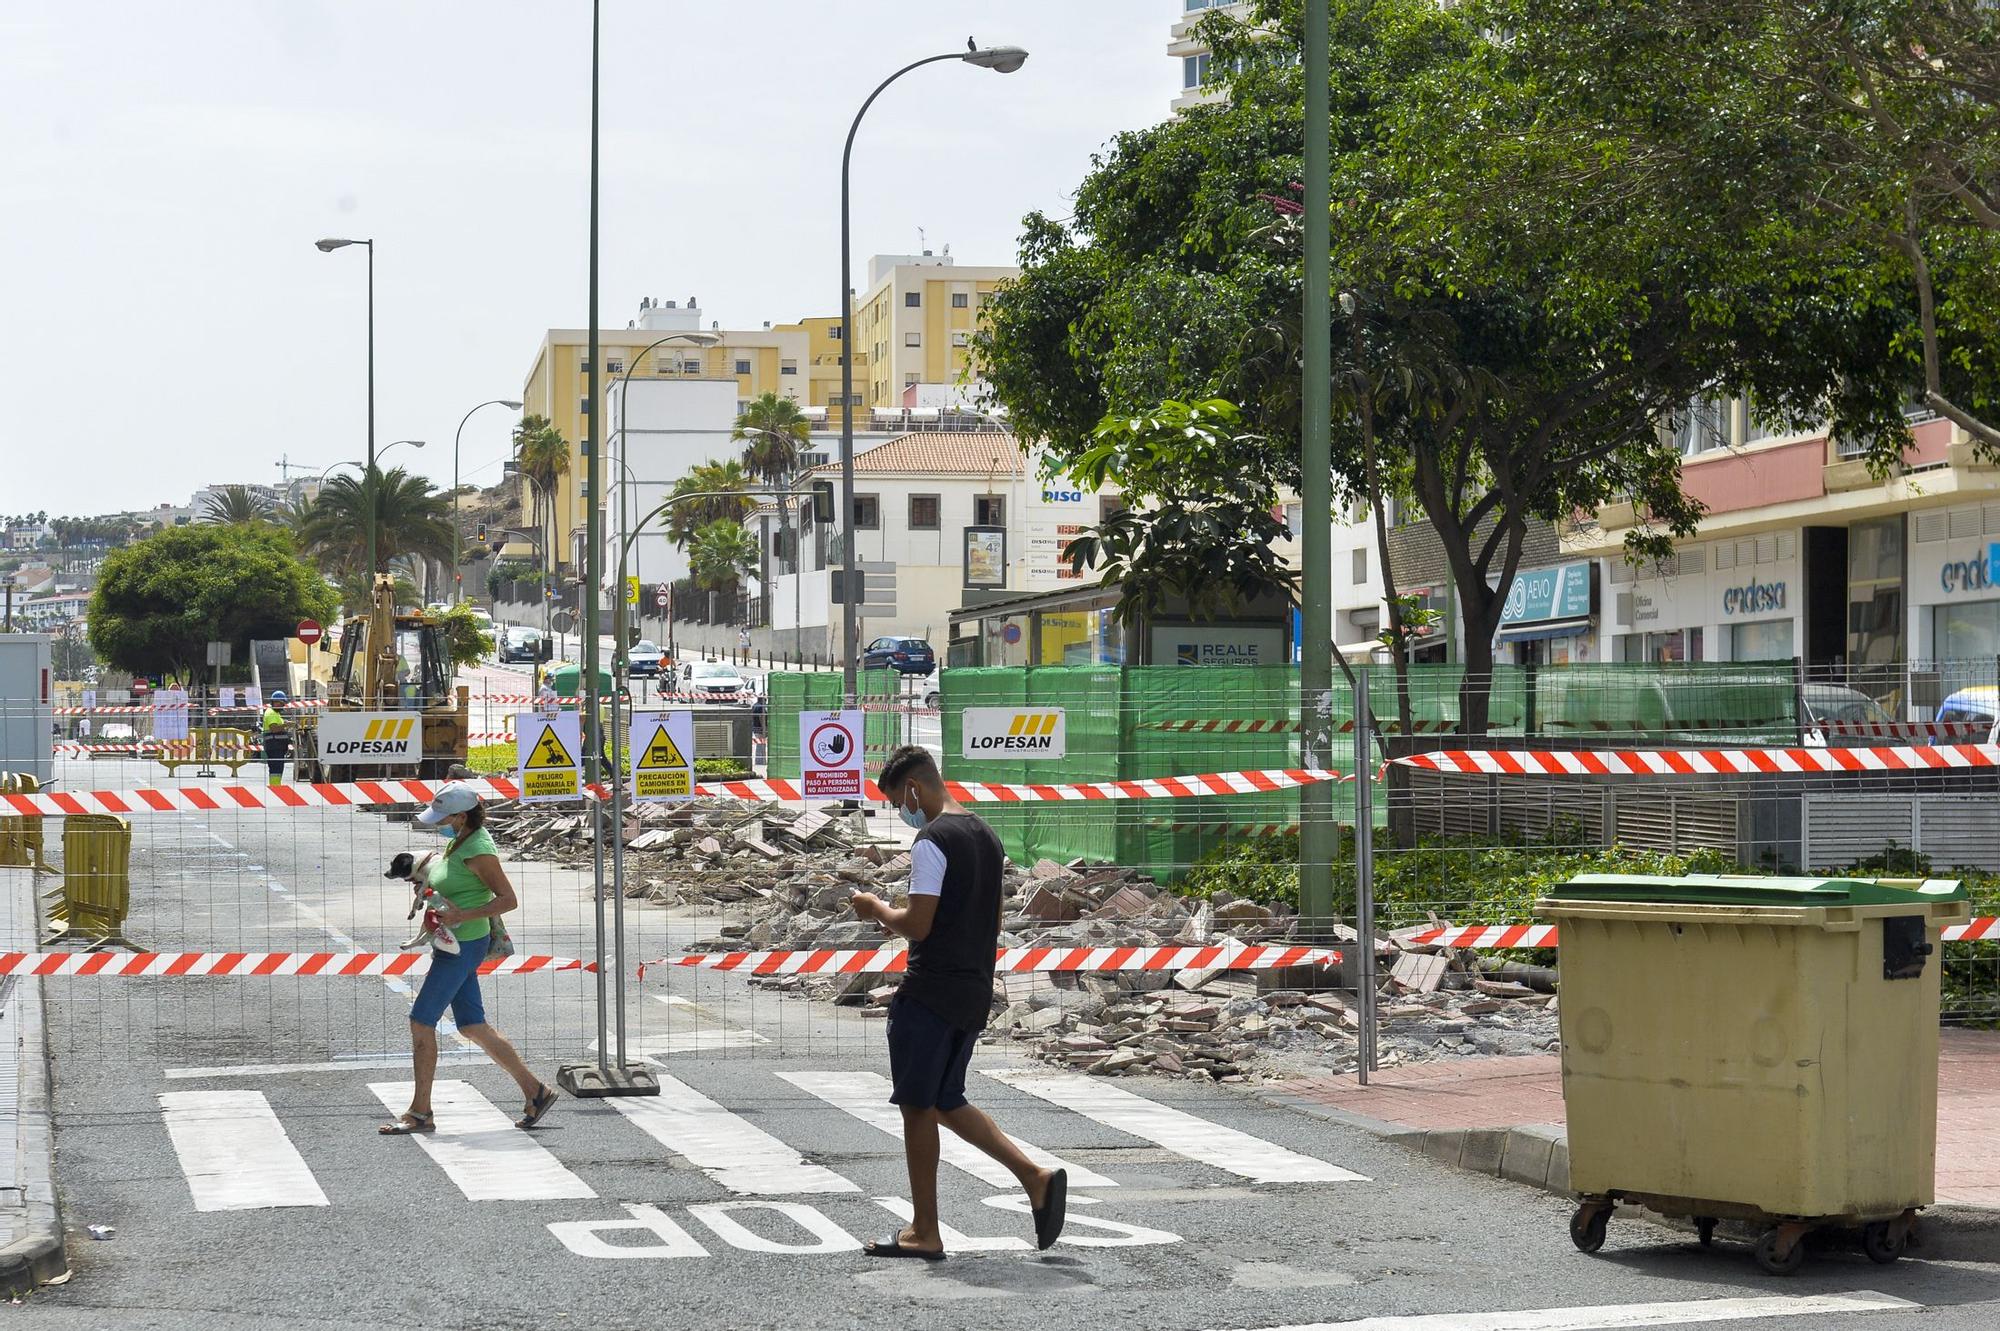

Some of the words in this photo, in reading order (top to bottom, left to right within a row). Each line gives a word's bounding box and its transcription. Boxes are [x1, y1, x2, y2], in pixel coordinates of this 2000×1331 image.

[1527, 578, 1550, 600] AEVO
[1635, 595, 1652, 608] Oficina
[1723, 576, 1786, 616] endesa
[1635, 608, 1659, 620] Comercial
[1203, 644, 1259, 656] REALE
[326, 740, 408, 754] LOPESAN
[970, 736, 1052, 749] LOPESAN
[638, 772, 685, 780] PRECAUCIÓN
[531, 788, 571, 796] MOVIMIENTO
[817, 785, 858, 793] AUTORIZADAS
[546, 1193, 1185, 1259] STOP
